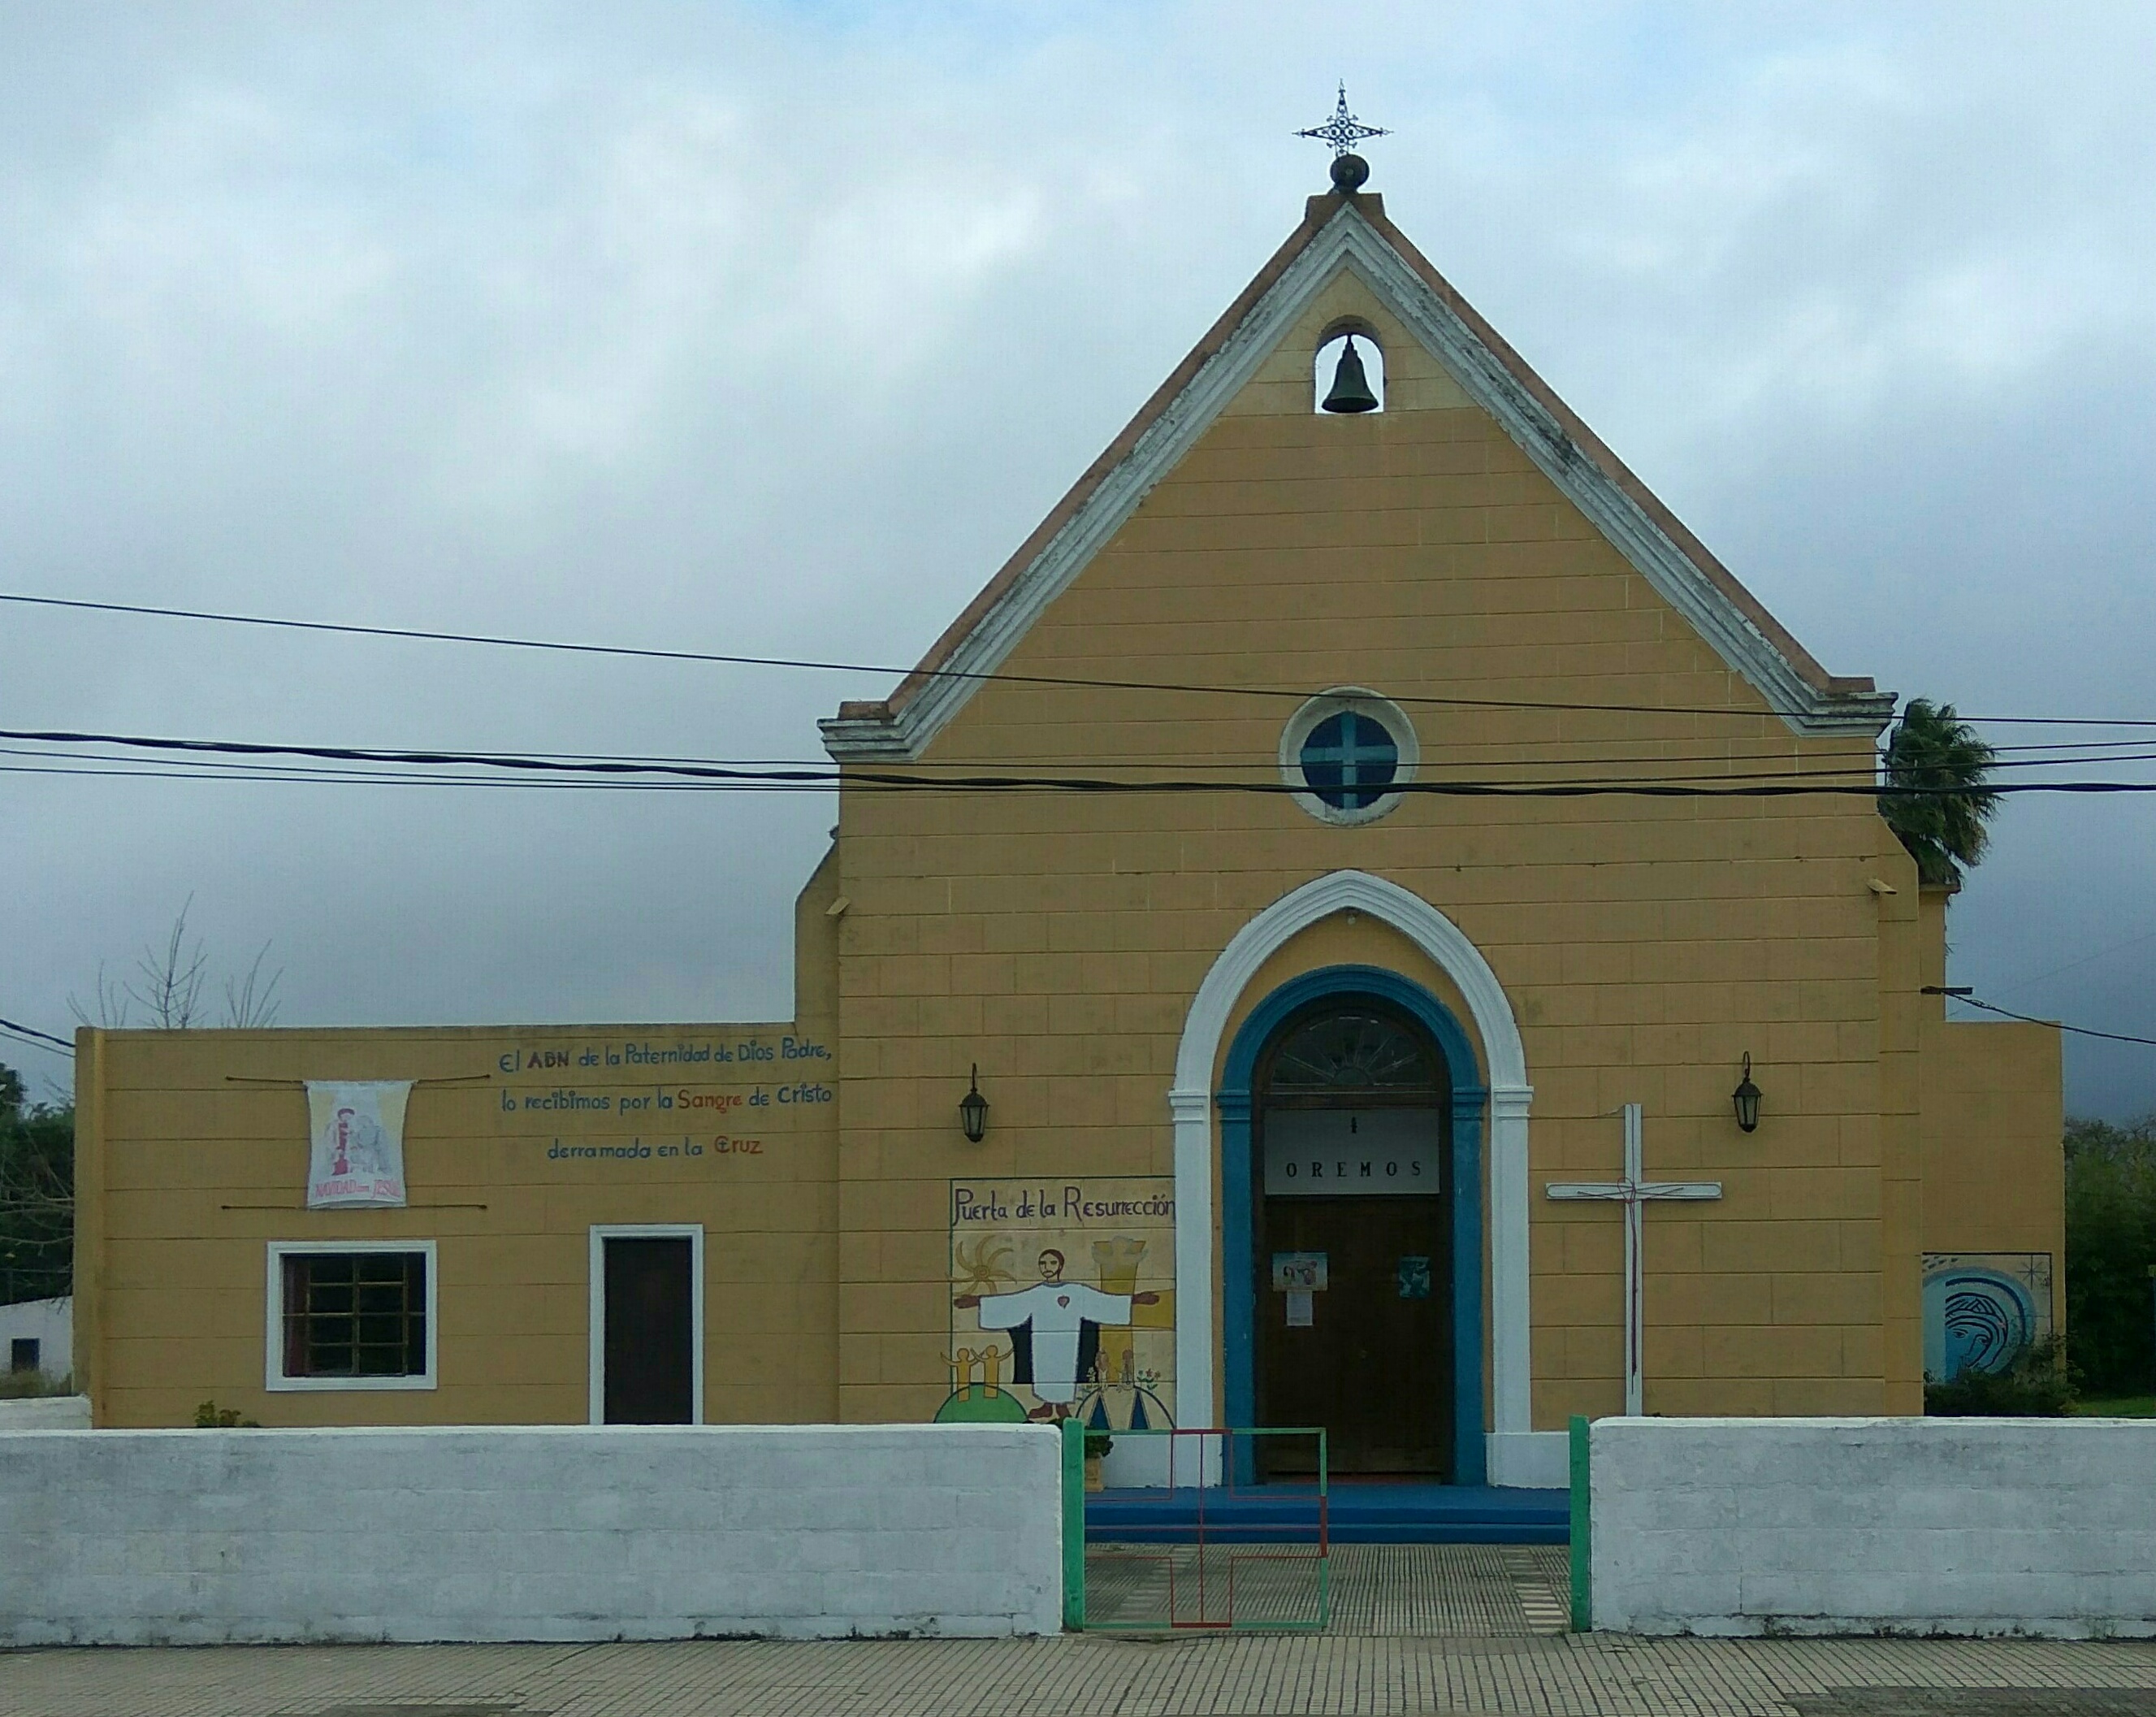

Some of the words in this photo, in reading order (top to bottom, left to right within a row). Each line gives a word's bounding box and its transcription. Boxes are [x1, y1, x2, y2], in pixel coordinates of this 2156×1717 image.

[499, 1049, 520, 1073] El
[527, 1051, 569, 1069] ADN
[579, 1047, 600, 1067] de
[605, 1046, 621, 1065] la
[626, 1043, 711, 1064] Paternidad
[714, 1046, 734, 1063] de
[738, 1040, 773, 1062] Dios
[781, 1037, 832, 1061] Padre,
[502, 1089, 516, 1112] lo
[525, 1086, 610, 1110] recibimos
[620, 1096, 651, 1116] por
[658, 1087, 673, 1109] la
[678, 1089, 742, 1114] Sangre
[749, 1086, 769, 1107] de
[777, 1082, 832, 1103] Cristo
[548, 1138, 651, 1159] derramada
[657, 1146, 678, 1157] en
[685, 1138, 703, 1156] la
[714, 1136, 764, 1154] Cruz
[952, 1188, 1008, 1226] Puerta
[1016, 1189, 1035, 1218] de
[1039, 1189, 1056, 1218] la
[1064, 1186, 1175, 1222] Resurrección
